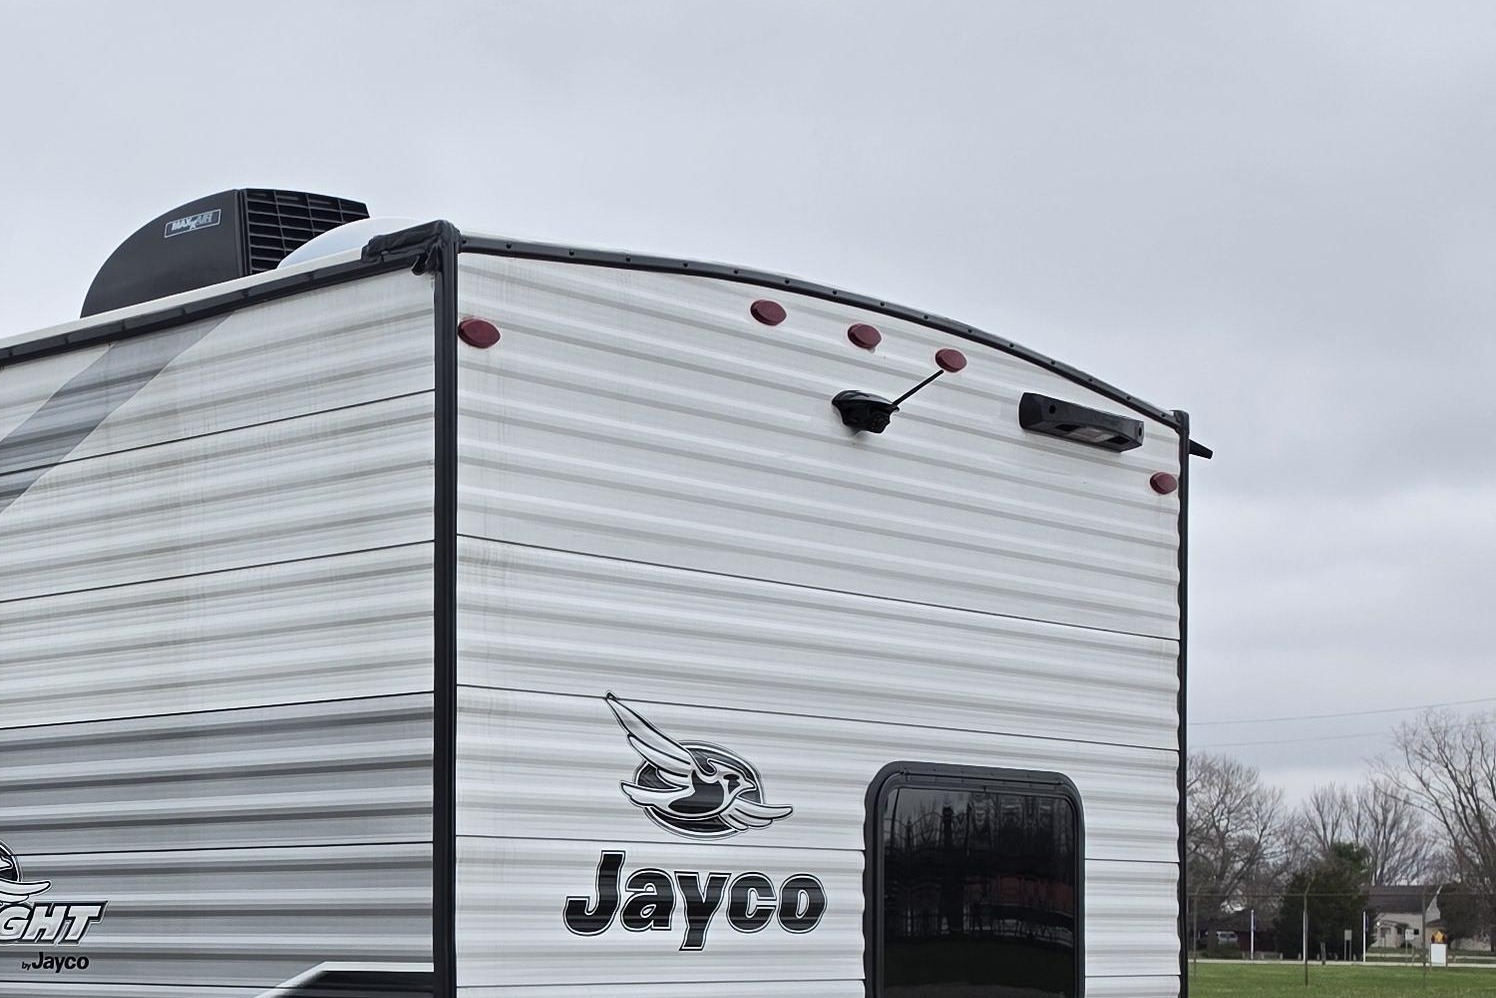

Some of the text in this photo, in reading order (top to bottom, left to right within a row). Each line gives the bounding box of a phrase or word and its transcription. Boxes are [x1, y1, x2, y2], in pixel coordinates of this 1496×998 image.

[562, 849, 829, 952] Jayco
[21, 951, 90, 973] by Jayco
